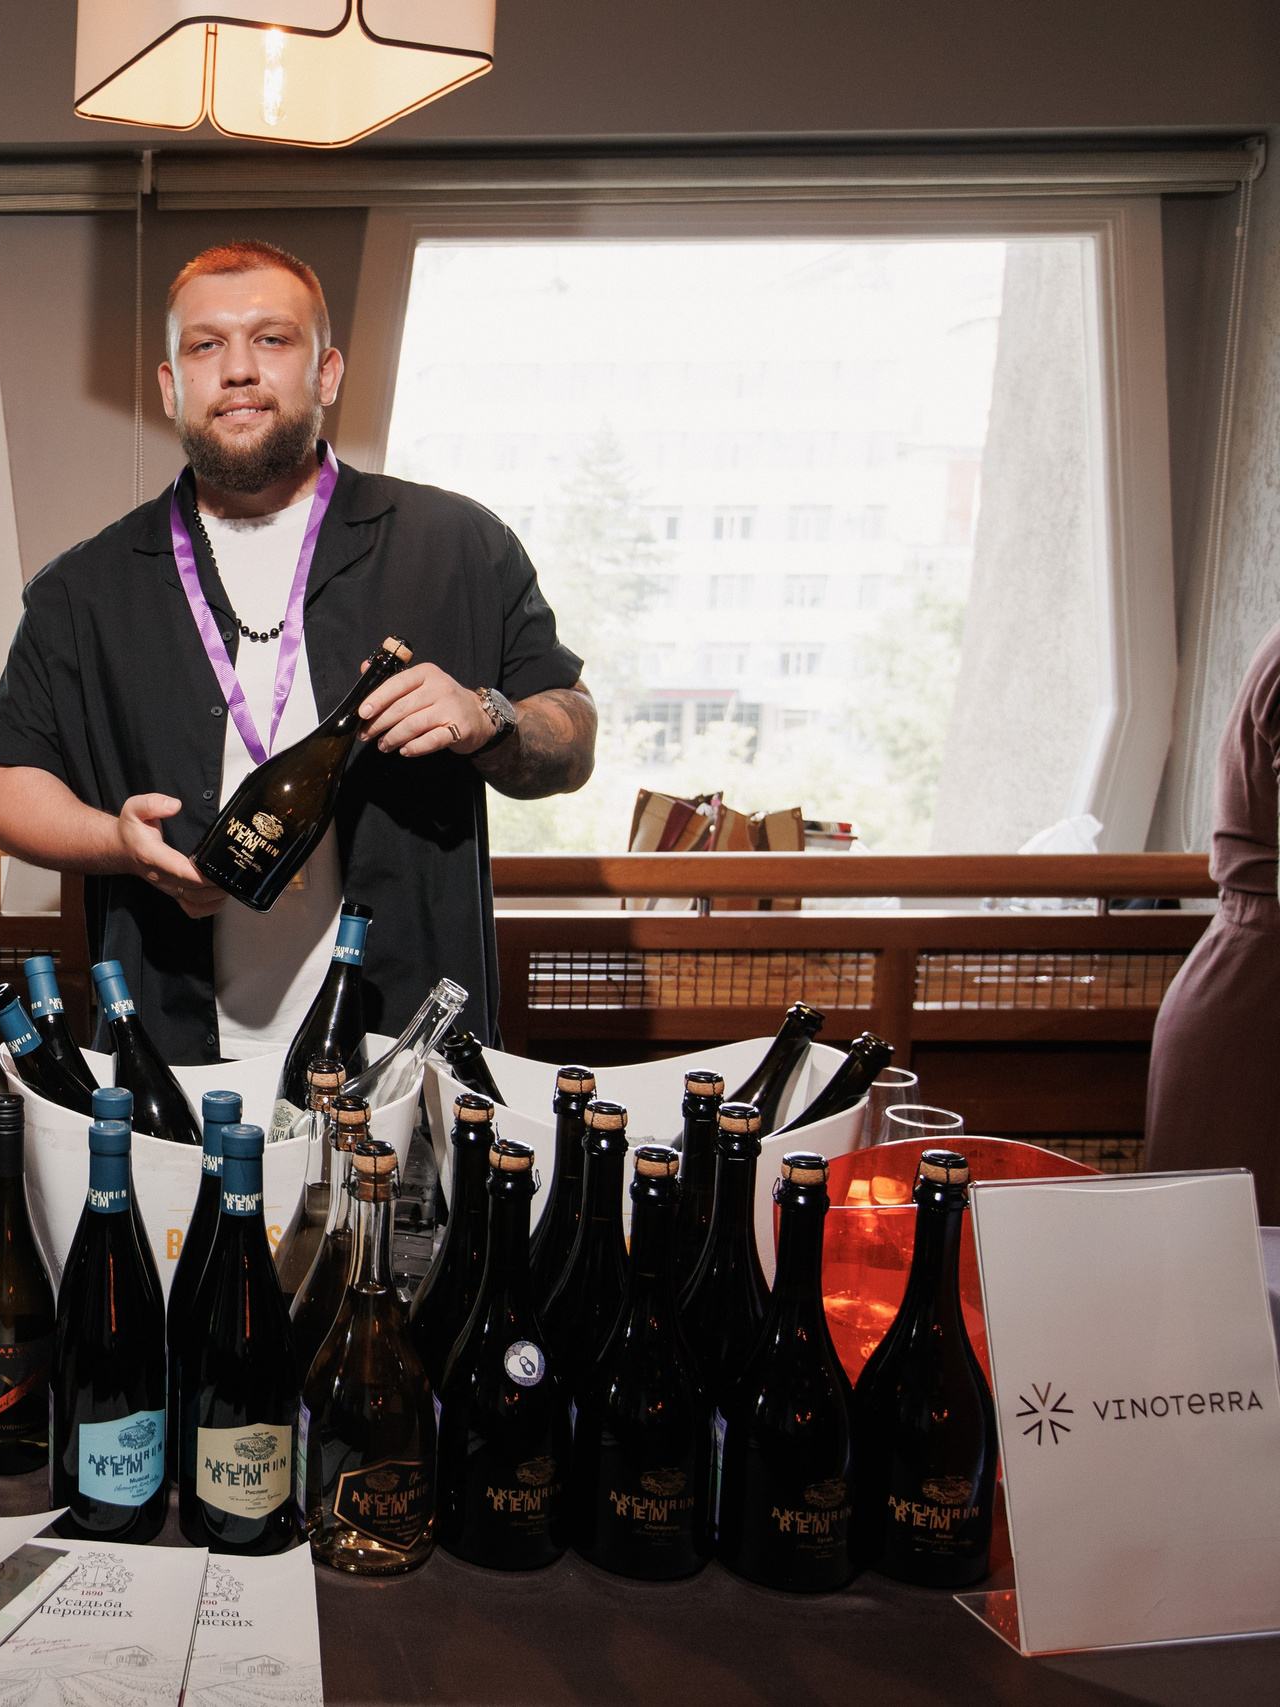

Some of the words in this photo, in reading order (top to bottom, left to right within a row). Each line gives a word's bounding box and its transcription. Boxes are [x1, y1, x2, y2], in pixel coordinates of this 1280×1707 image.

[129, 1473, 150, 1484] Muscat
[55, 1597, 122, 1609] Усадьба
[39, 1606, 134, 1618] Перовских
